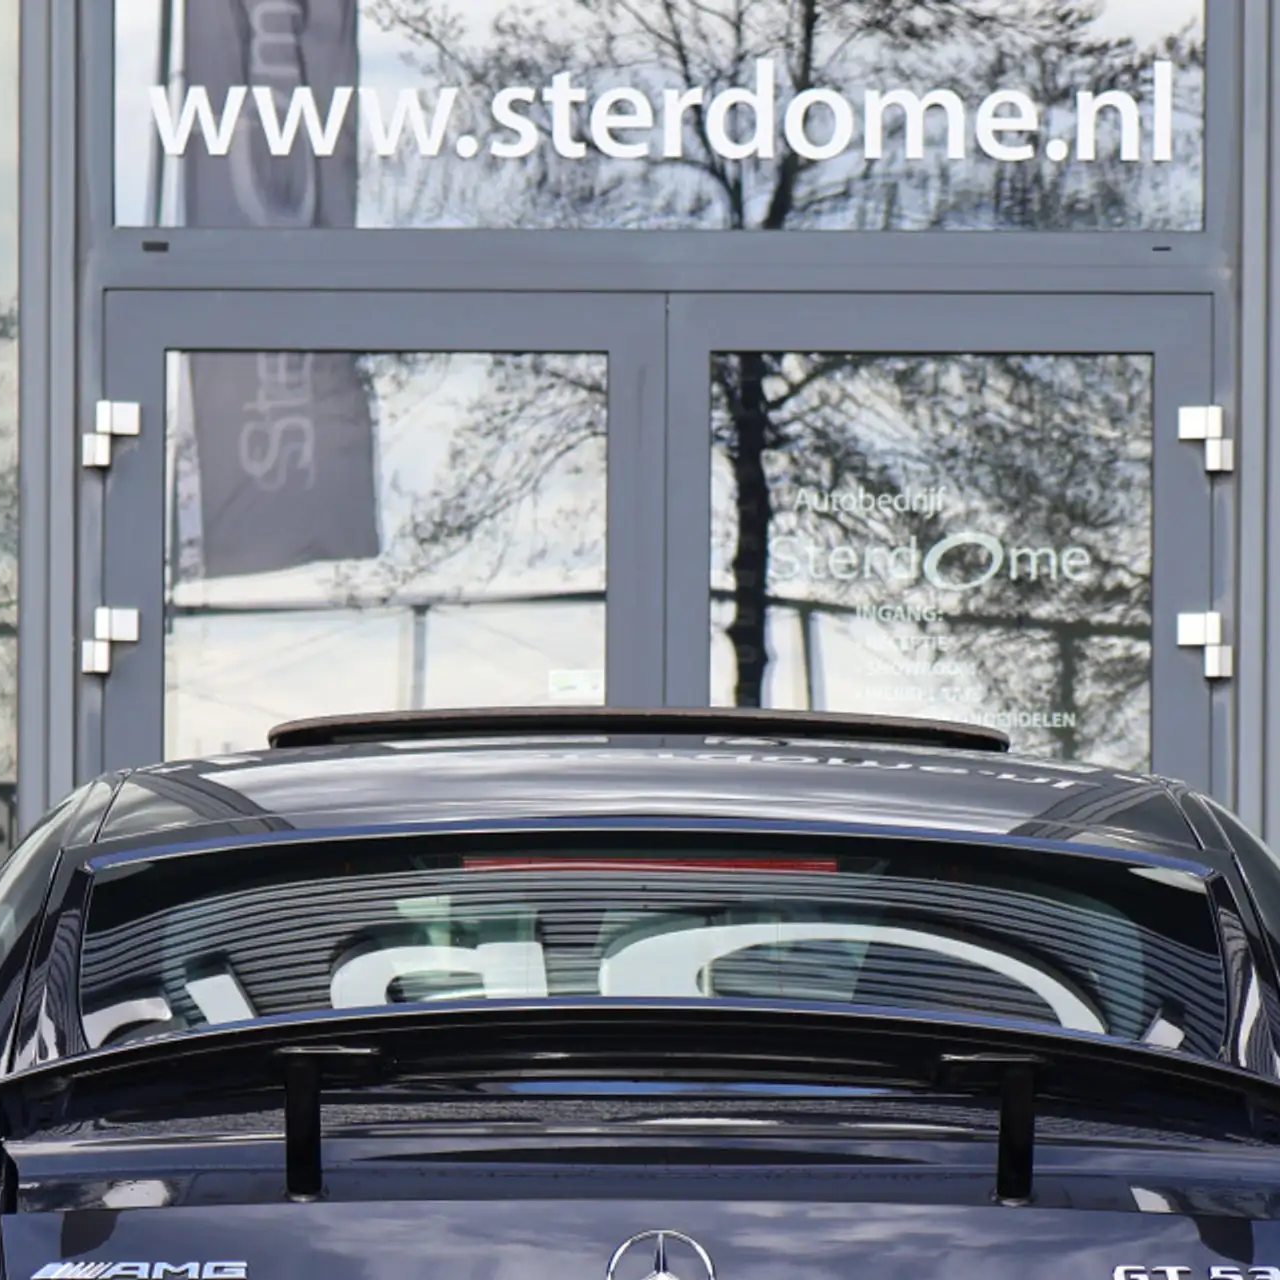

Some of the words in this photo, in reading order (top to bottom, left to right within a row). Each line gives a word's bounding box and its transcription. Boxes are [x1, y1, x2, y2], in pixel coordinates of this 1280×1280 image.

[148, 59, 1173, 162] www.sterdome.nl
[793, 487, 946, 517] Autobedrijf
[767, 531, 1092, 590] SterdOme
